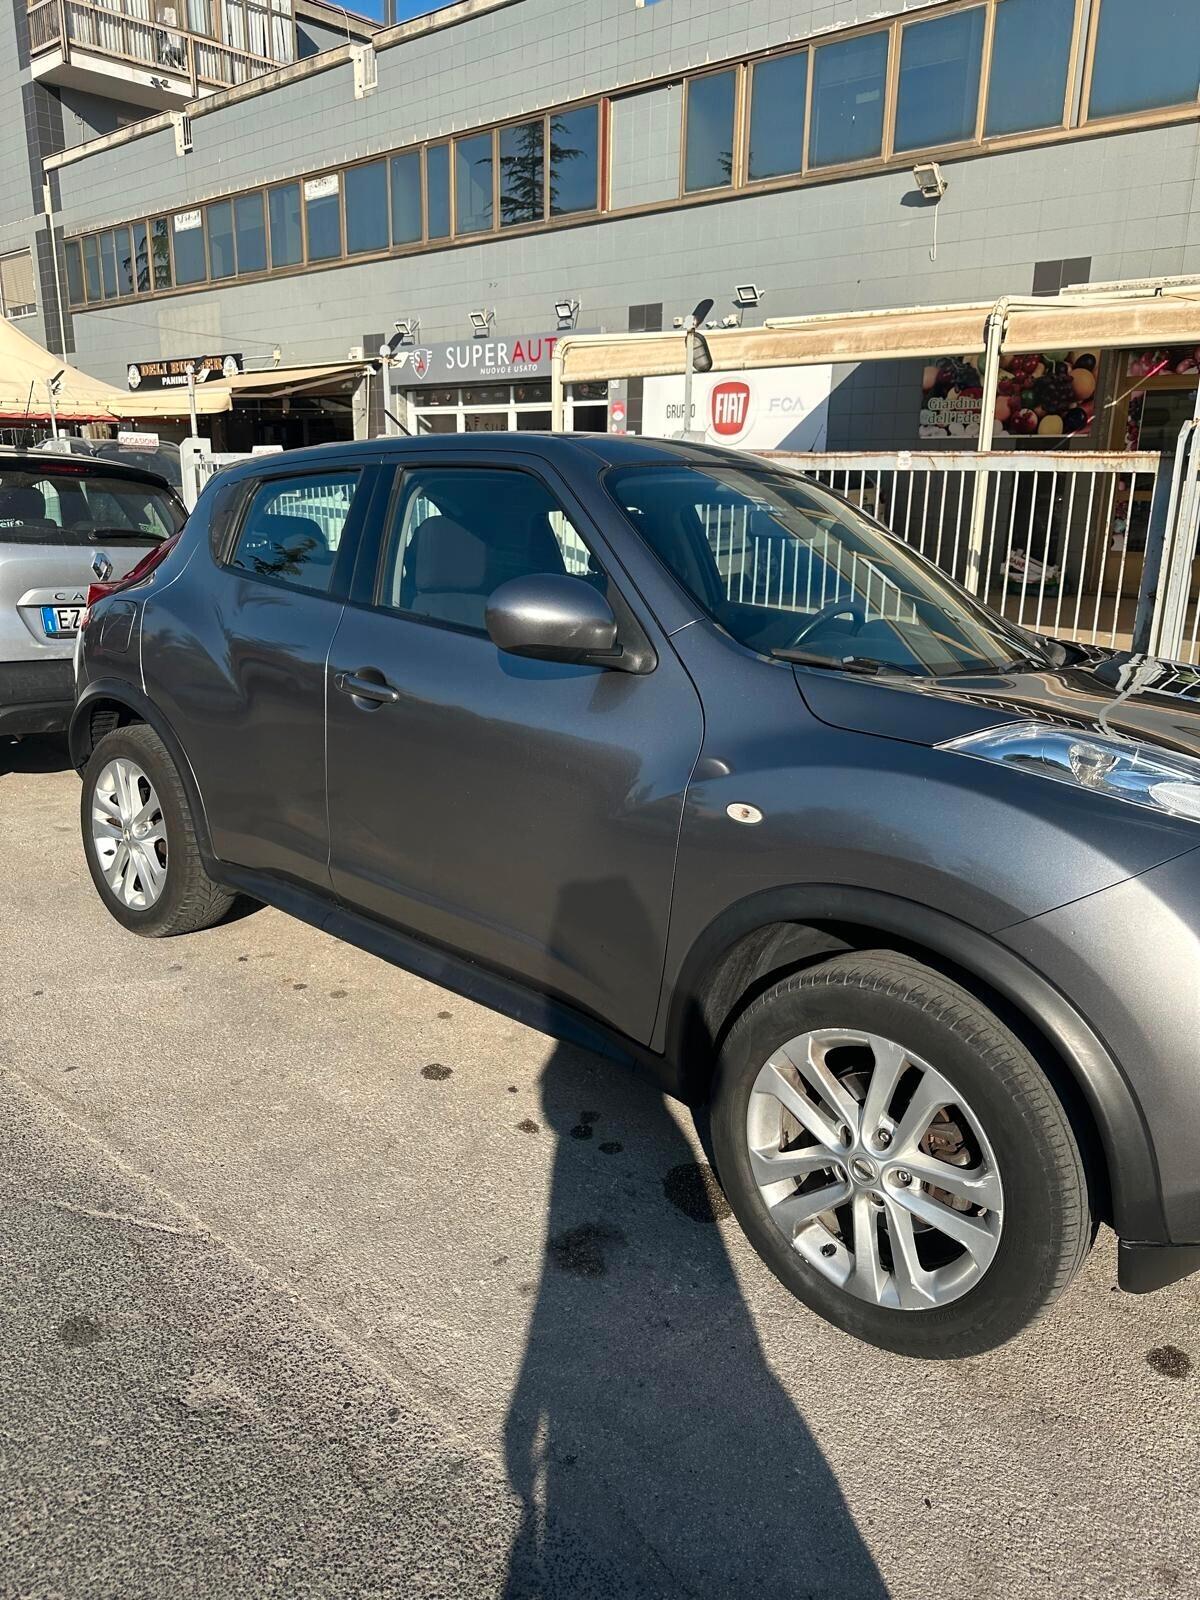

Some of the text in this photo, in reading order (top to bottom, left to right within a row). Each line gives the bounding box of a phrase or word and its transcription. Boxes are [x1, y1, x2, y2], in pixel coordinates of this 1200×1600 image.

[446, 337, 557, 369] SUPERAUT
[140, 358, 223, 376] DELI BURER
[480, 366, 506, 375] NUOVO
[513, 364, 538, 373] USATO
[161, 375, 188, 386] PANINE
[666, 392, 804, 424] GRUPO FIAT FCA
[928, 410, 981, 425] dell'Ede
[119, 435, 159, 446] OCCASIONE
